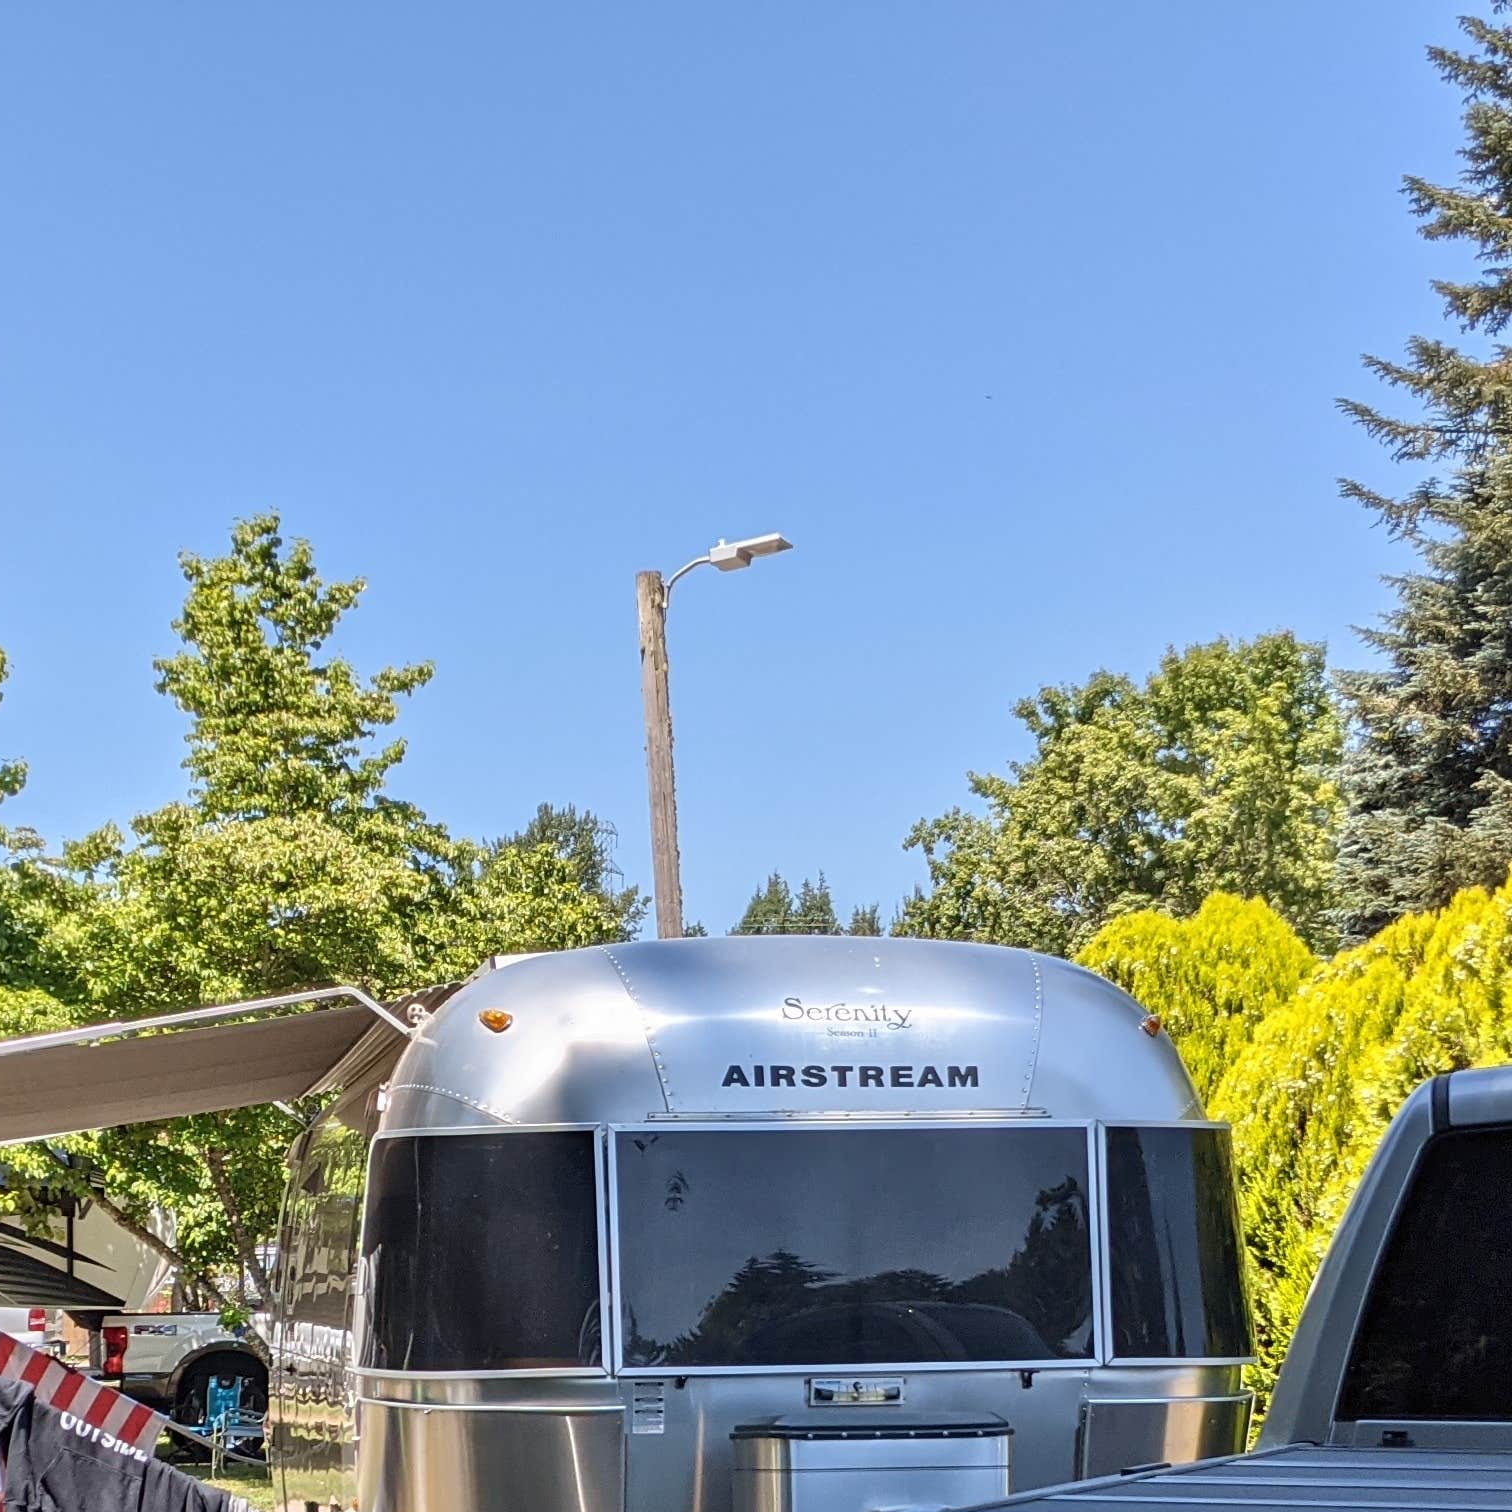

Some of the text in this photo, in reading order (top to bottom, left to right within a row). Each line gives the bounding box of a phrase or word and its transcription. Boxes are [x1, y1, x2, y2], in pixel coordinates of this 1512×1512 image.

[781, 997, 913, 1031] Serenity
[826, 1027, 864, 1038] Season
[721, 1064, 980, 1088] AIRSTREAM
